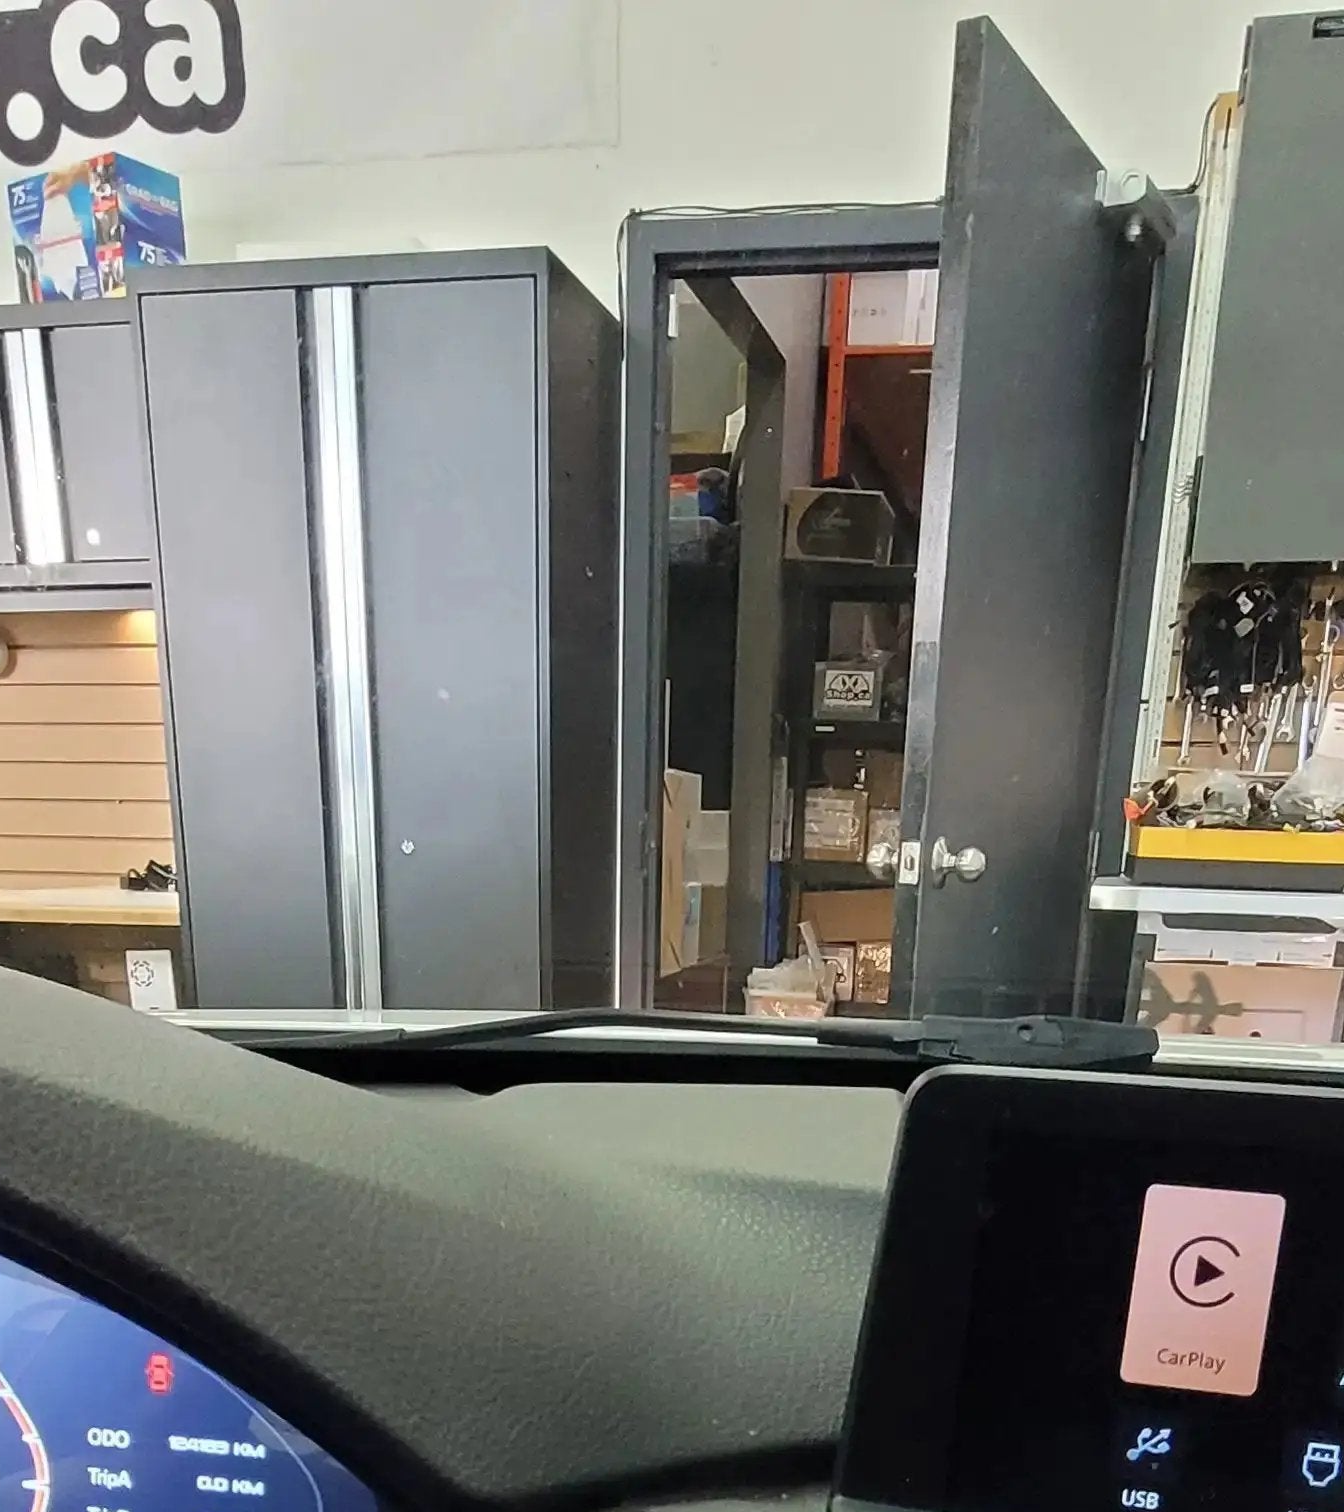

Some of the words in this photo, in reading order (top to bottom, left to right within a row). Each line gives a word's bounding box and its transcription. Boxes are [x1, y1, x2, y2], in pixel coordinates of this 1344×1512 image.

[11, 184, 26, 207] 75
[1154, 1347, 1228, 1376] CarPlay
[86, 1426, 131, 1450] ODO
[232, 1440, 266, 1460] KM
[86, 1465, 133, 1491] TripA
[231, 1478, 265, 1497] KM
[1120, 1487, 1160, 1512] USB
